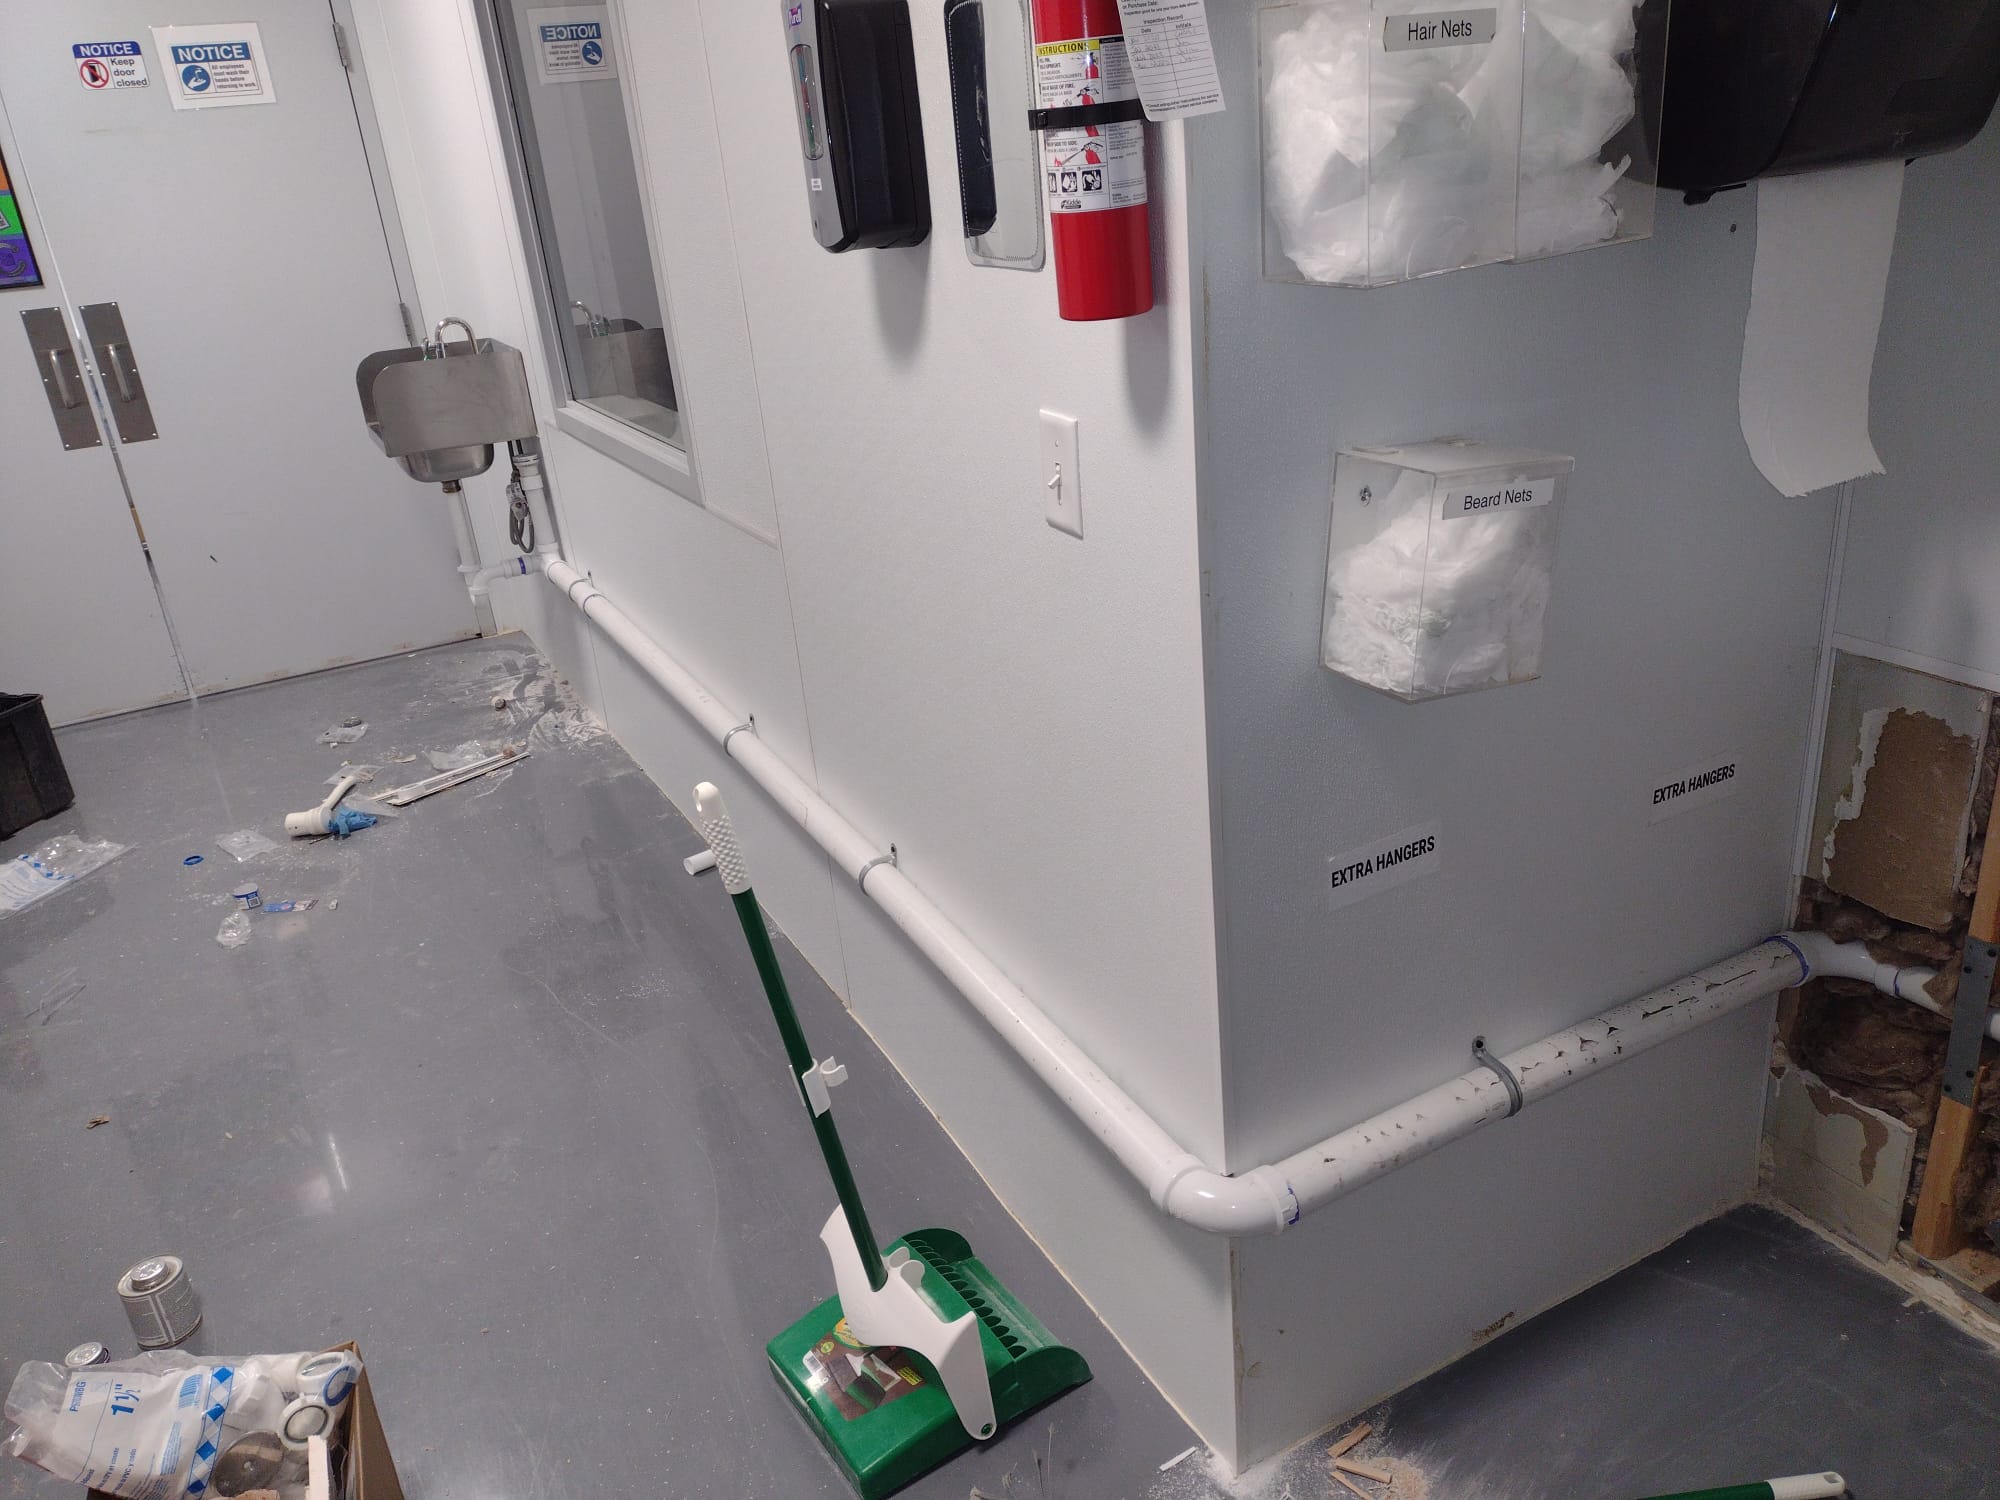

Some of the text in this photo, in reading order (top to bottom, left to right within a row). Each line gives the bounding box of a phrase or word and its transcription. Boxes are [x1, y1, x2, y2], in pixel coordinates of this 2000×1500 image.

[1408, 20, 1472, 41] Hair Nets
[80, 43, 134, 56] NOTICE
[178, 45, 245, 62] NOTICE
[116, 78, 147, 86] closed
[1464, 489, 1532, 510] Beard Nets
[1653, 764, 1735, 804] EXTRA HANGERS
[1332, 836, 1435, 888] EXTRA HANGERS
